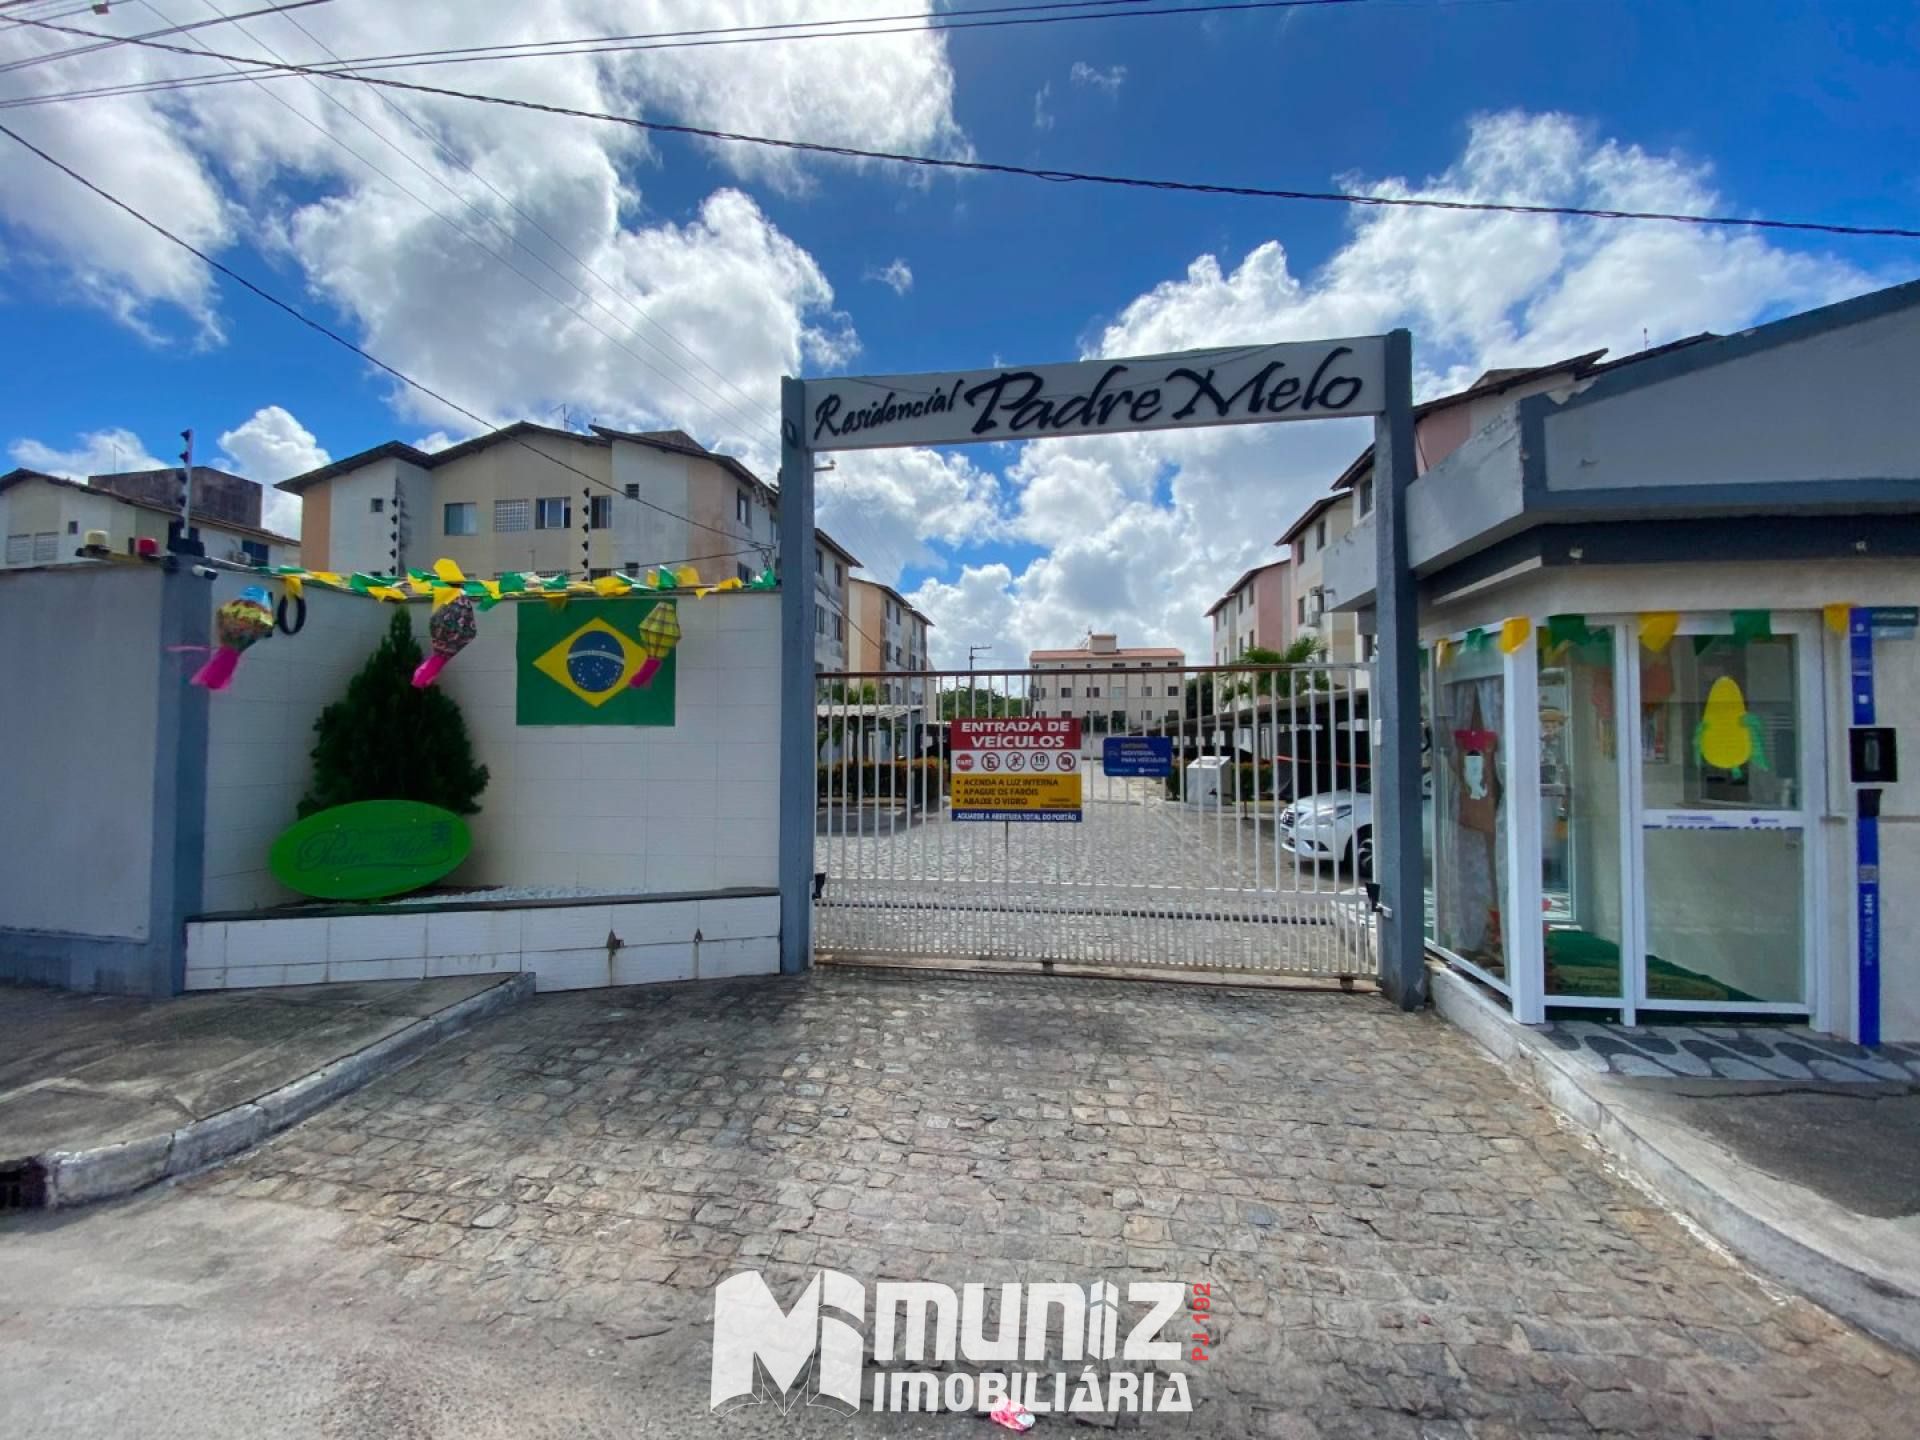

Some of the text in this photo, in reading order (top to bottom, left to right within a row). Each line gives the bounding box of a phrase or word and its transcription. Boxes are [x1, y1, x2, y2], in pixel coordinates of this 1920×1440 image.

[813, 346, 1362, 441] Residencial Padre Melo
[961, 721, 1070, 732] ENTRADA DE
[971, 733, 1065, 748] VEÍCULOS
[963, 788, 996, 796] APAGUE
[998, 788, 1007, 796] OS
[963, 797, 1028, 805] ABAIXE O VIDRO
[957, 812, 1077, 821] AGUARDE A ABERTURA TOTAL DO PORTÃO
